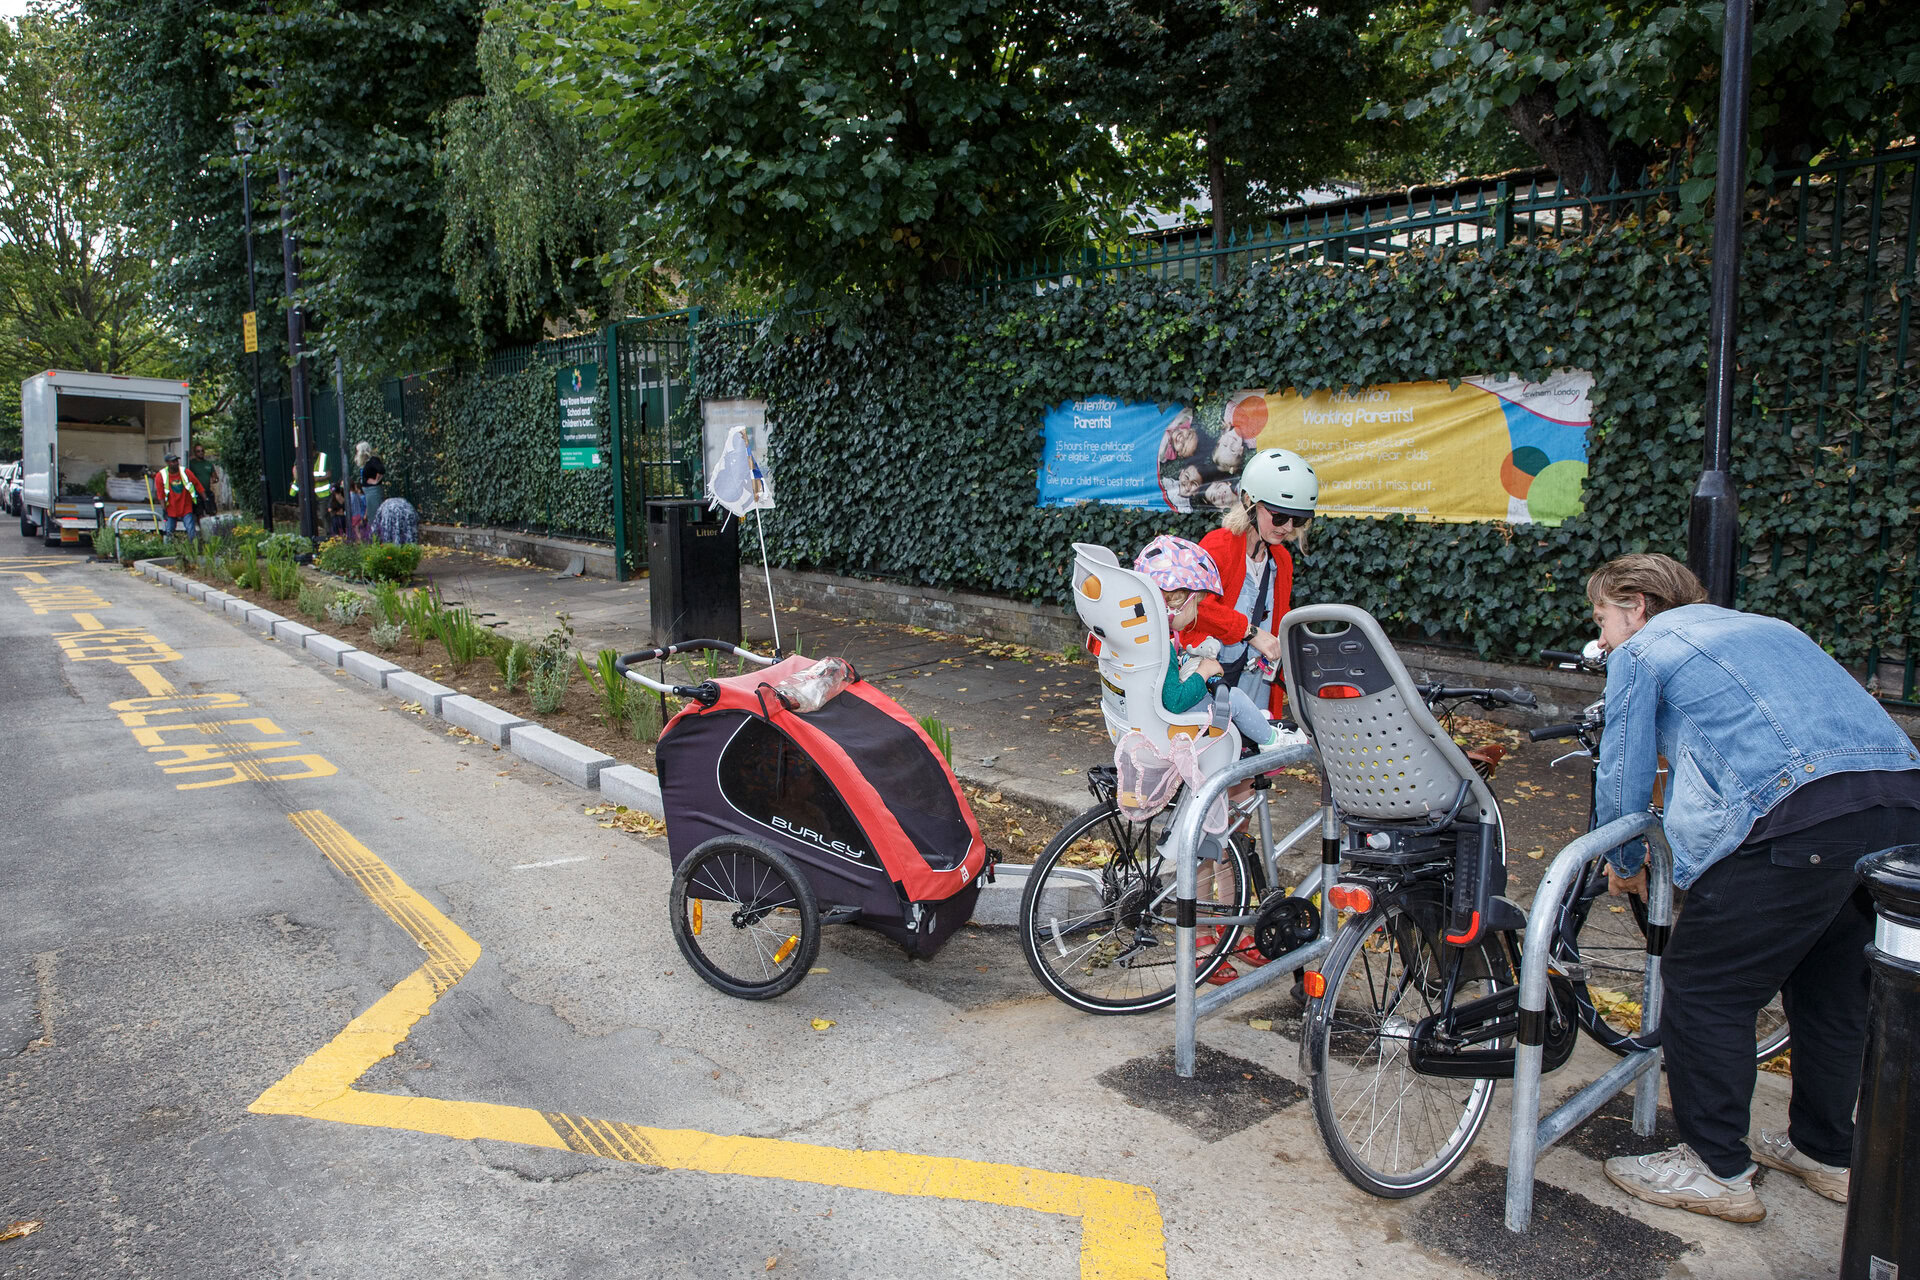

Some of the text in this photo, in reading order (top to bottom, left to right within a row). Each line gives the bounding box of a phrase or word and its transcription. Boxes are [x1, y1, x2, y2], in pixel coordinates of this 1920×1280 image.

[1553, 388, 1580, 396] London
[1073, 398, 1118, 412] Attention
[567, 406, 590, 417] School and
[1303, 407, 1414, 428] Working Parents!
[1074, 415, 1112, 429] Parents!
[1055, 441, 1135, 452] 15 hours free childcare
[1311, 438, 1341, 451] hours
[1406, 449, 1429, 461] olds
[1060, 476, 1075, 487] your
[1076, 475, 1092, 486] child
[1093, 475, 1106, 486] the
[1106, 475, 1123, 487] best
[1125, 477, 1145, 487] start
[1331, 479, 1352, 489] and
[1385, 480, 1408, 491] miss
[696, 528, 718, 537] Litter
[52, 627, 184, 664] KEEP
[108, 692, 339, 791] CLEAR
[771, 815, 865, 859] BURLEY
